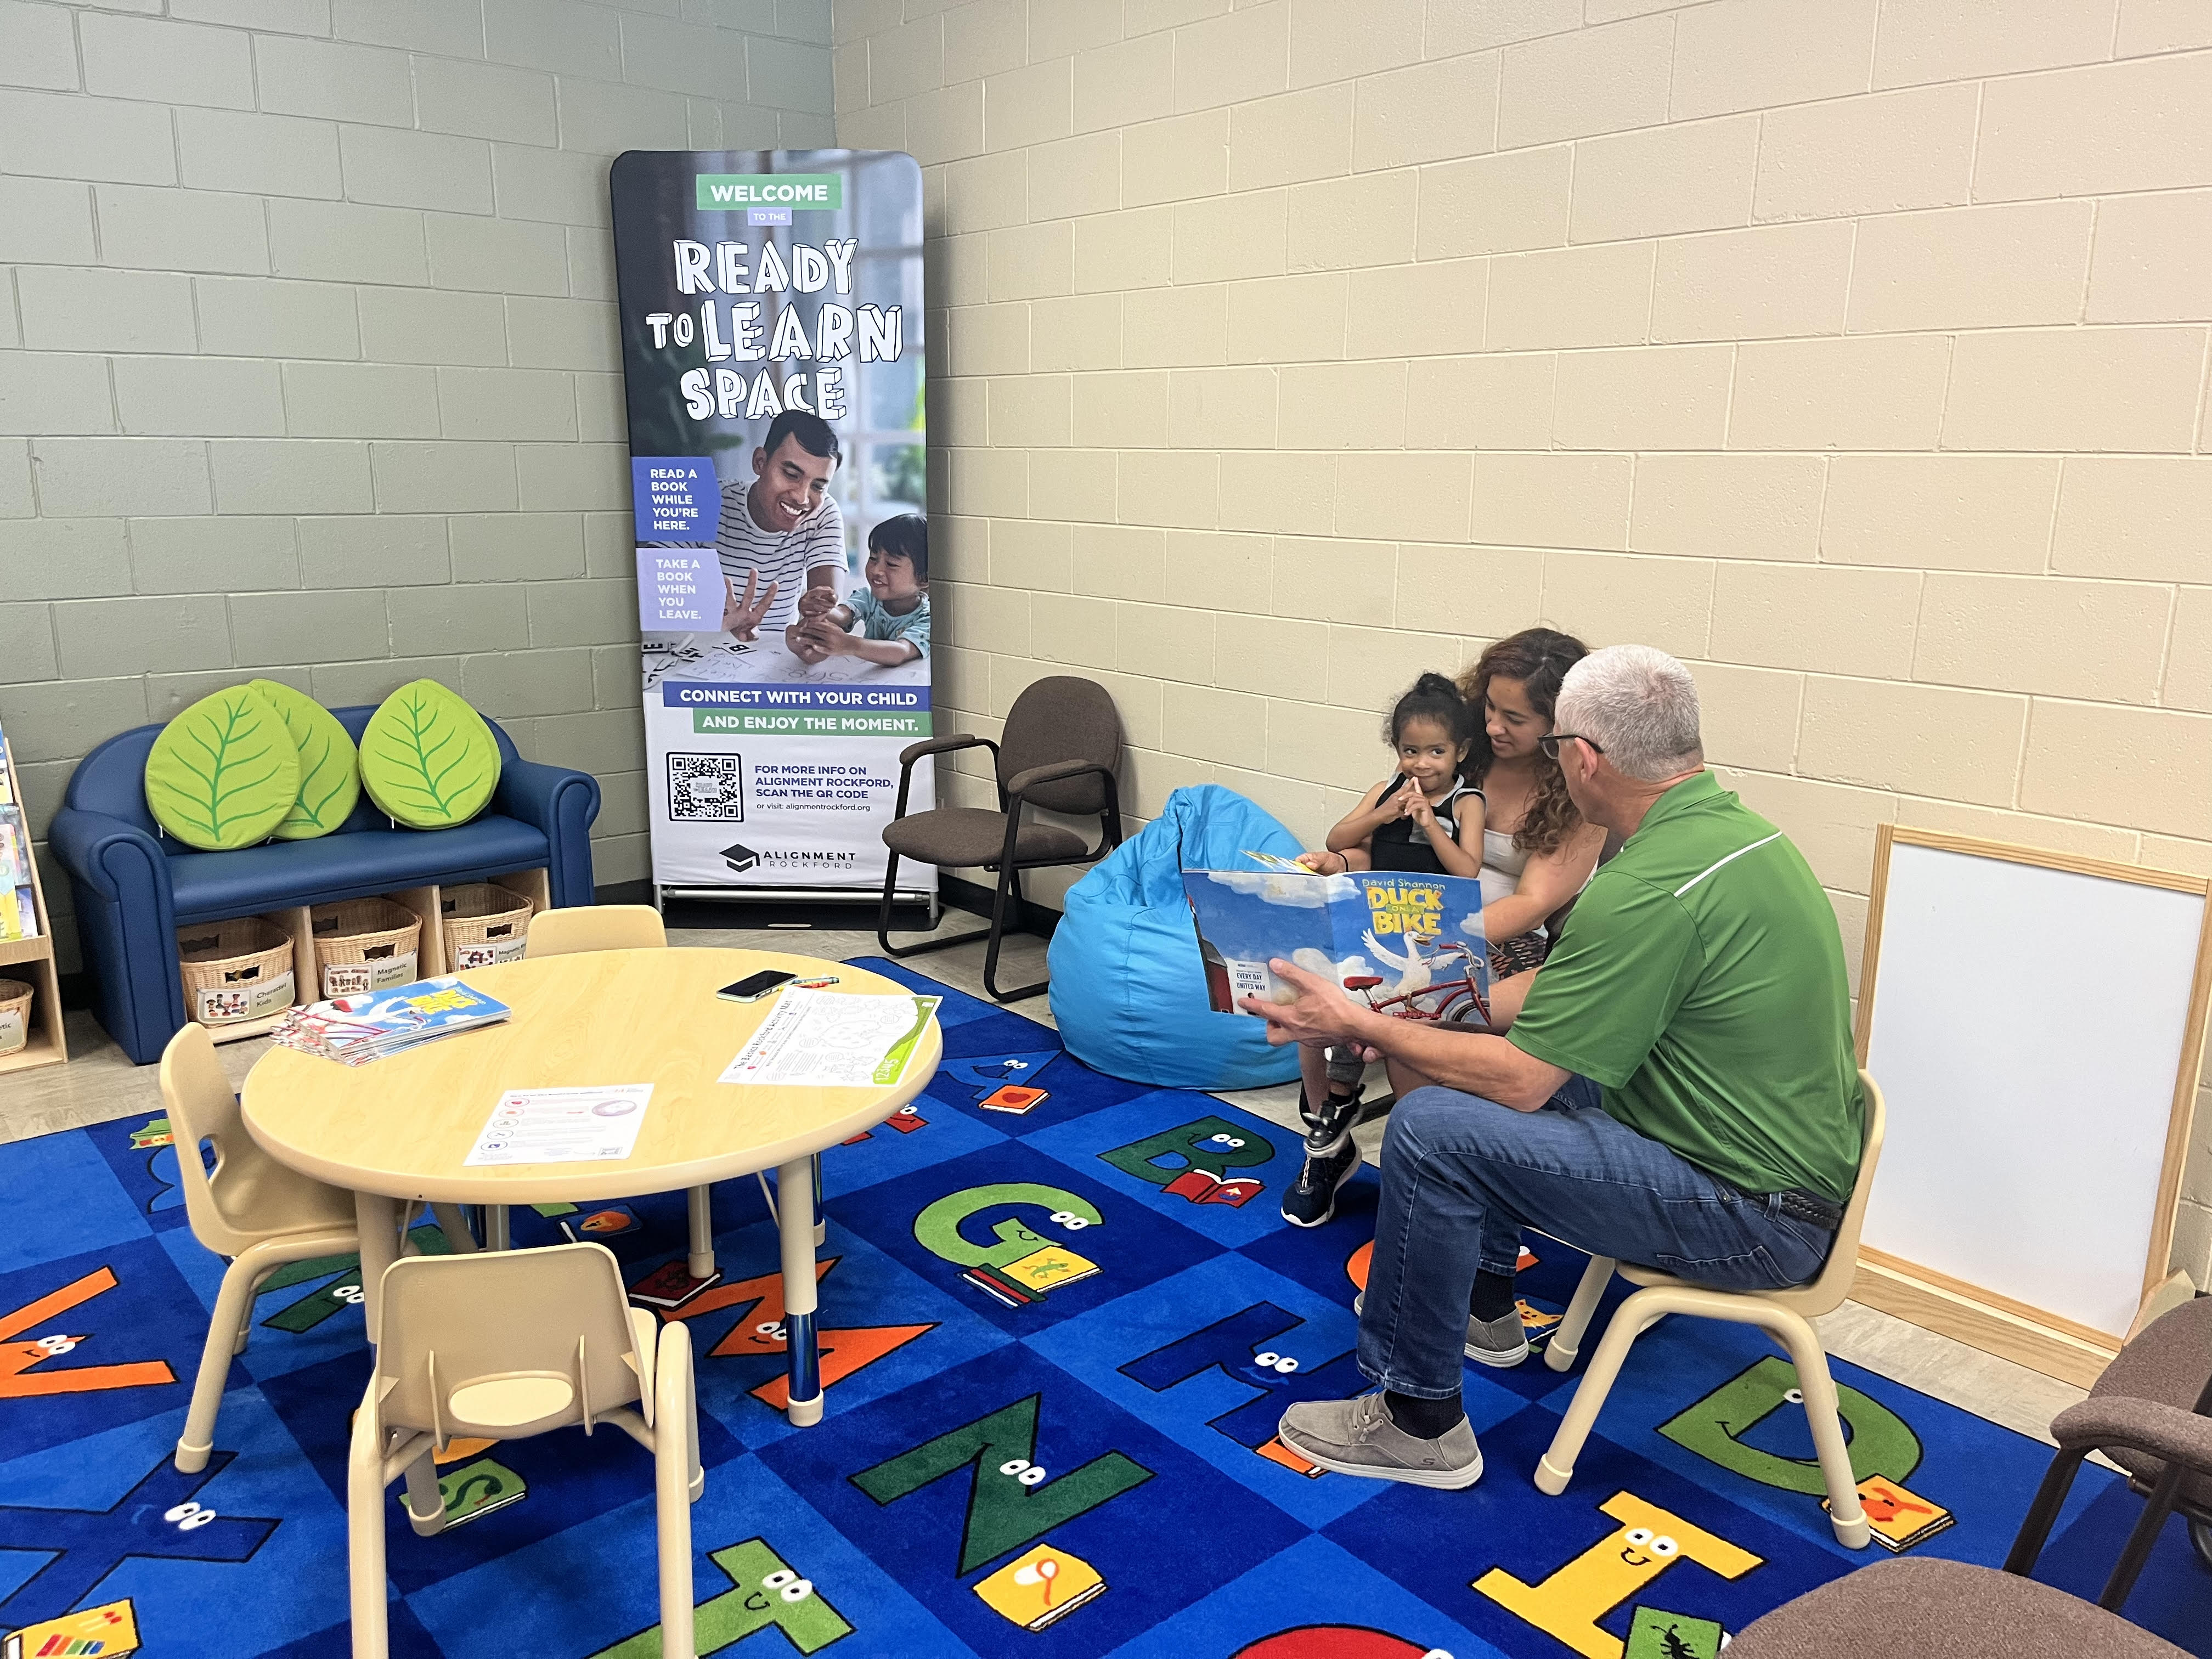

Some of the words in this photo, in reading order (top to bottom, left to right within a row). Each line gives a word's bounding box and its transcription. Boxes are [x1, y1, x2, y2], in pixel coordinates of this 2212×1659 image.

[710, 184, 828, 202] WELCOME
[753, 212, 766, 221] TO
[768, 212, 787, 221] THE
[673, 238, 859, 295] READY
[646, 313, 695, 349] TO
[700, 300, 904, 363] LEARN
[680, 366, 847, 421] SPACE
[650, 469, 685, 478] READ
[688, 469, 698, 478] A
[651, 482, 688, 491] BOOK
[652, 495, 693, 504] WHILE
[652, 507, 699, 517] YOU'RE
[653, 521, 690, 531] HERE.
[656, 558, 689, 568] TAKE
[691, 559, 701, 569] A
[657, 572, 693, 582] BOOK
[657, 584, 696, 594] WHEN
[658, 597, 684, 606] YOU
[659, 610, 702, 619] LEAVE.
[680, 689, 762, 703] CONNECT
[766, 691, 811, 704] WITH
[815, 692, 863, 705] YOUR
[867, 692, 918, 706] CHILD
[702, 715, 740, 728] AND
[744, 716, 799, 729] ENJOY
[803, 717, 837, 730] THE
[842, 718, 919, 731] MOMENT.
[755, 765, 778, 774] FOR
[782, 766, 815, 774] MORE
[818, 766, 846, 775] INFO
[849, 766, 867, 775] ON
[755, 777, 823, 786] ALIGNMENT
[826, 778, 894, 789] ROCKFORD,
[756, 788, 788, 797] SCAN
[791, 789, 814, 798] THE
[816, 790, 833, 798] QR
[836, 790, 868, 799] CODE
[786, 803, 871, 812] alignmentrockford.org
[763, 851, 856, 861] ALIGNMENT
[770, 861, 853, 870] ROCKFORD
[1362, 879, 1395, 887] David
[1398, 879, 1446, 890] Shannon
[1367, 887, 1444, 911] DUCK
[1372, 911, 1442, 935] BIKE
[377, 963, 407, 975] Magnetic
[377, 973, 404, 983] Families
[257, 983, 287, 998] Character
[257, 998, 272, 1007] Kids
[733, 1060, 747, 1069] The
[911, 1182, 1105, 1271] G
